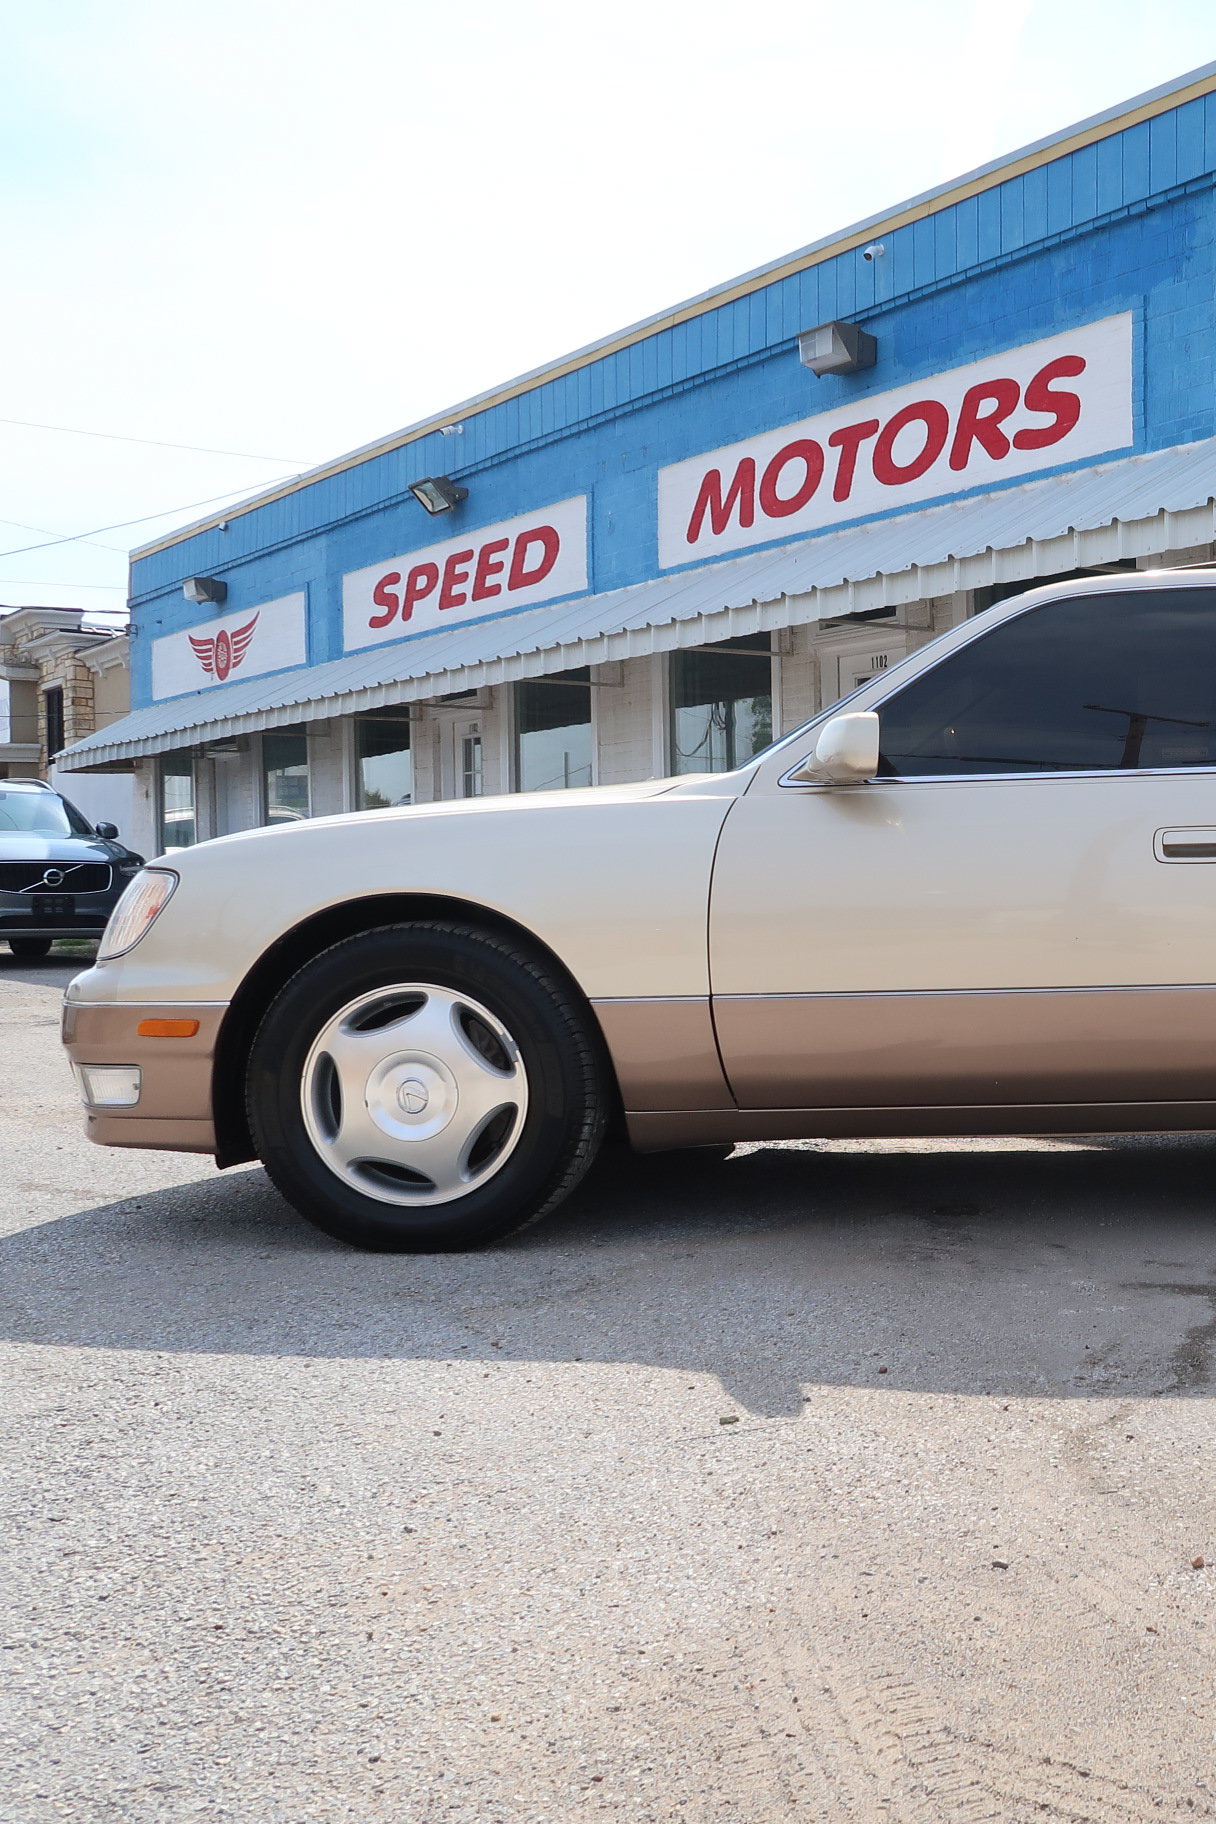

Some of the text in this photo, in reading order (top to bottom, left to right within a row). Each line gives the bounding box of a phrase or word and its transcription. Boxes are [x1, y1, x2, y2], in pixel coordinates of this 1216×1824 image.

[687, 355, 1086, 543] MOTORS
[370, 525, 560, 628] SPEED
[871, 654, 888, 669] 1102
